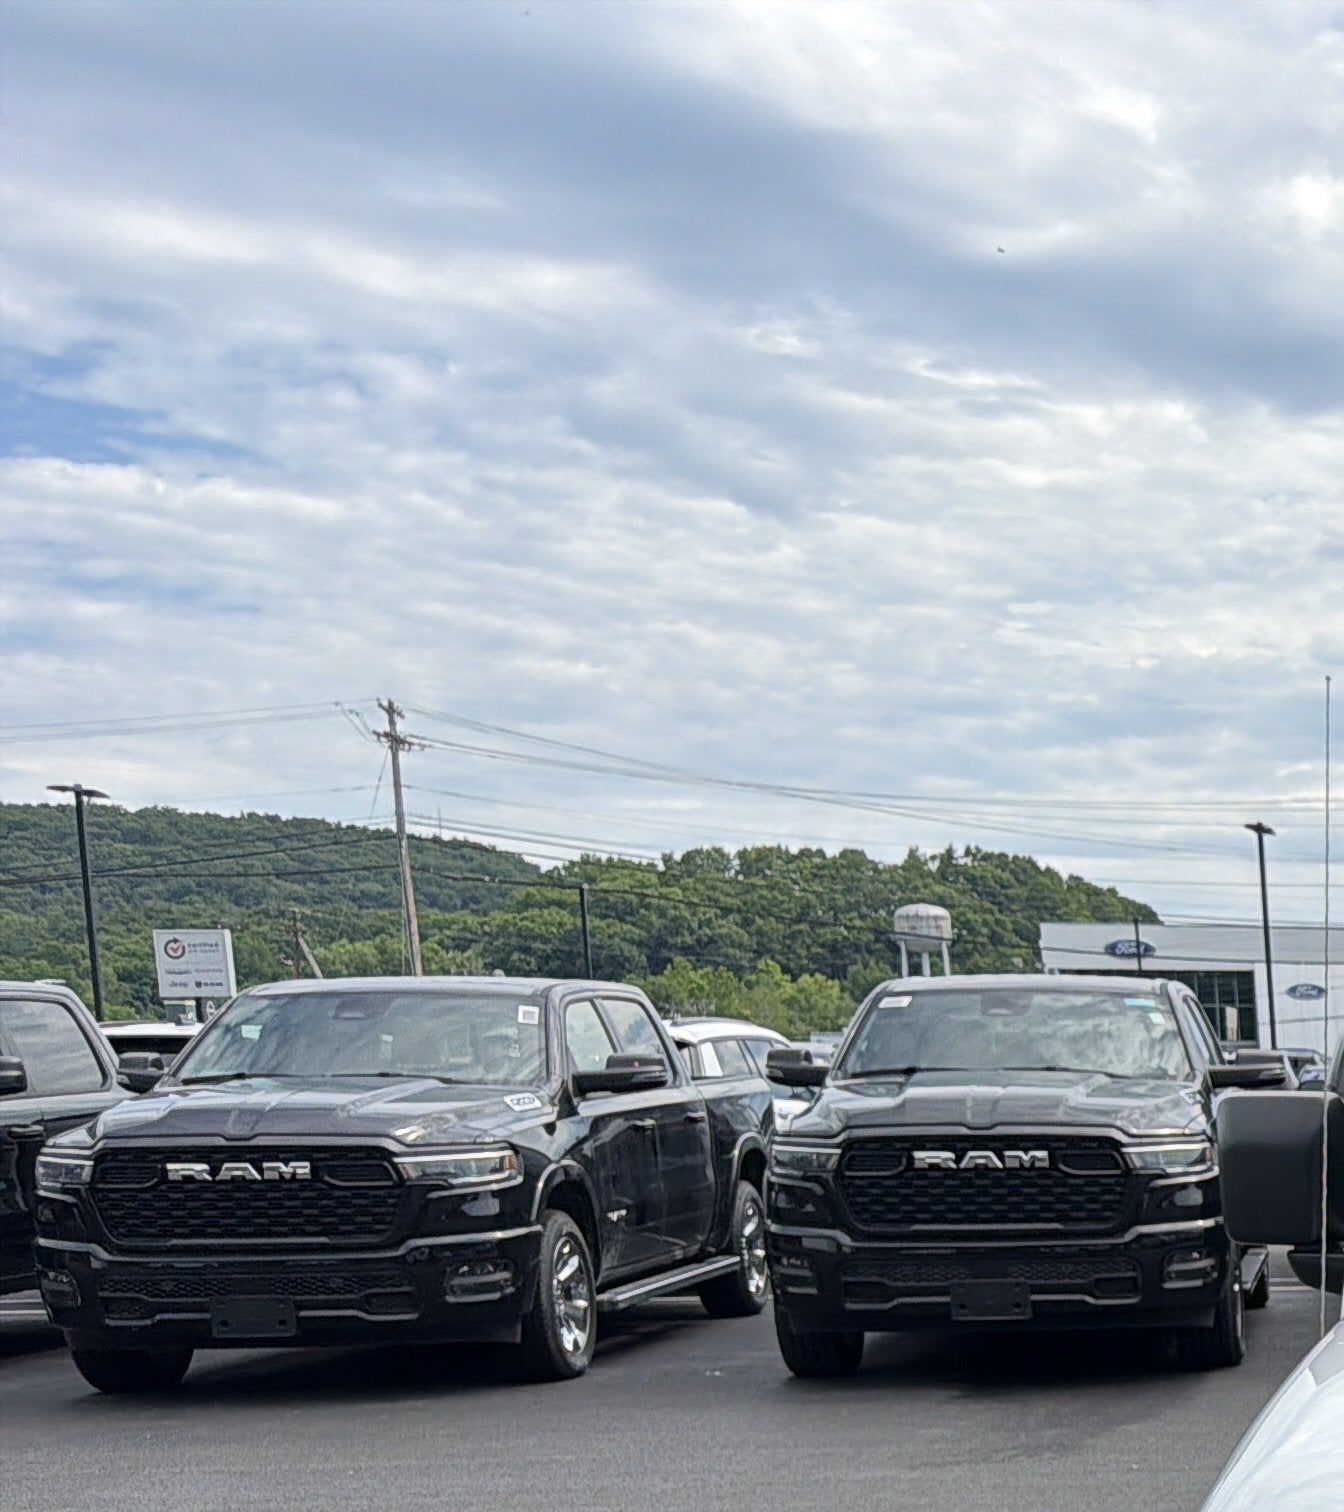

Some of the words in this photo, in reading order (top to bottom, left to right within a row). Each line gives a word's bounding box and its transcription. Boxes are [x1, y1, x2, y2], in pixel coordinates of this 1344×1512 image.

[1115, 942, 1146, 955] Ford
[912, 1150, 1050, 1169] RAM
[165, 1161, 312, 1181] RAM
